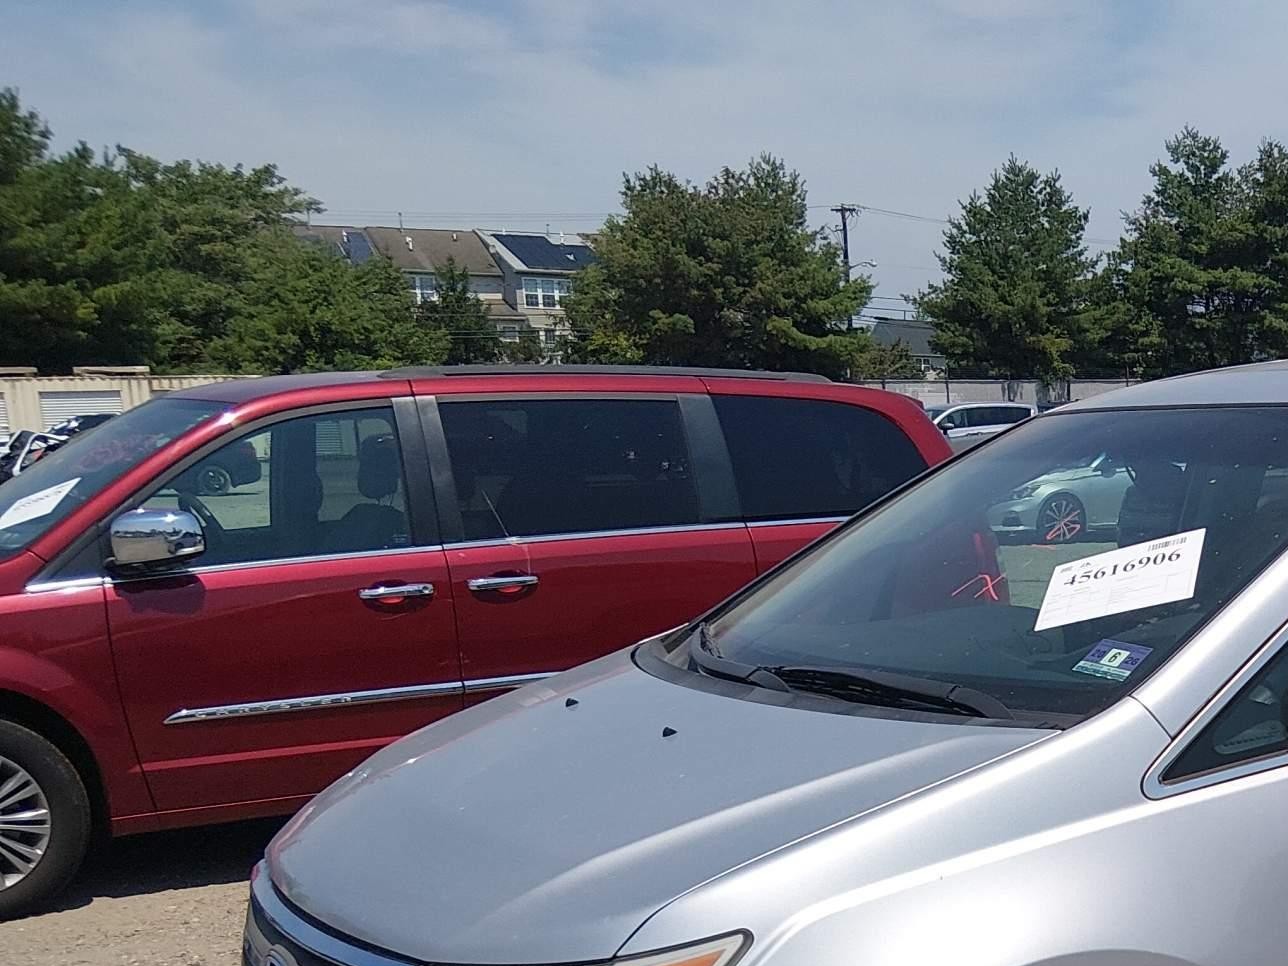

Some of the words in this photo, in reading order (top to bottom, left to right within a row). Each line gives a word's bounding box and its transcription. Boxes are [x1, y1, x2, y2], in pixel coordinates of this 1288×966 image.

[1063, 548, 1182, 587] 45616906
[1107, 651, 1121, 663] 6
[1125, 656, 1140, 666] 26
[194, 695, 353, 718] CHRYSLER
